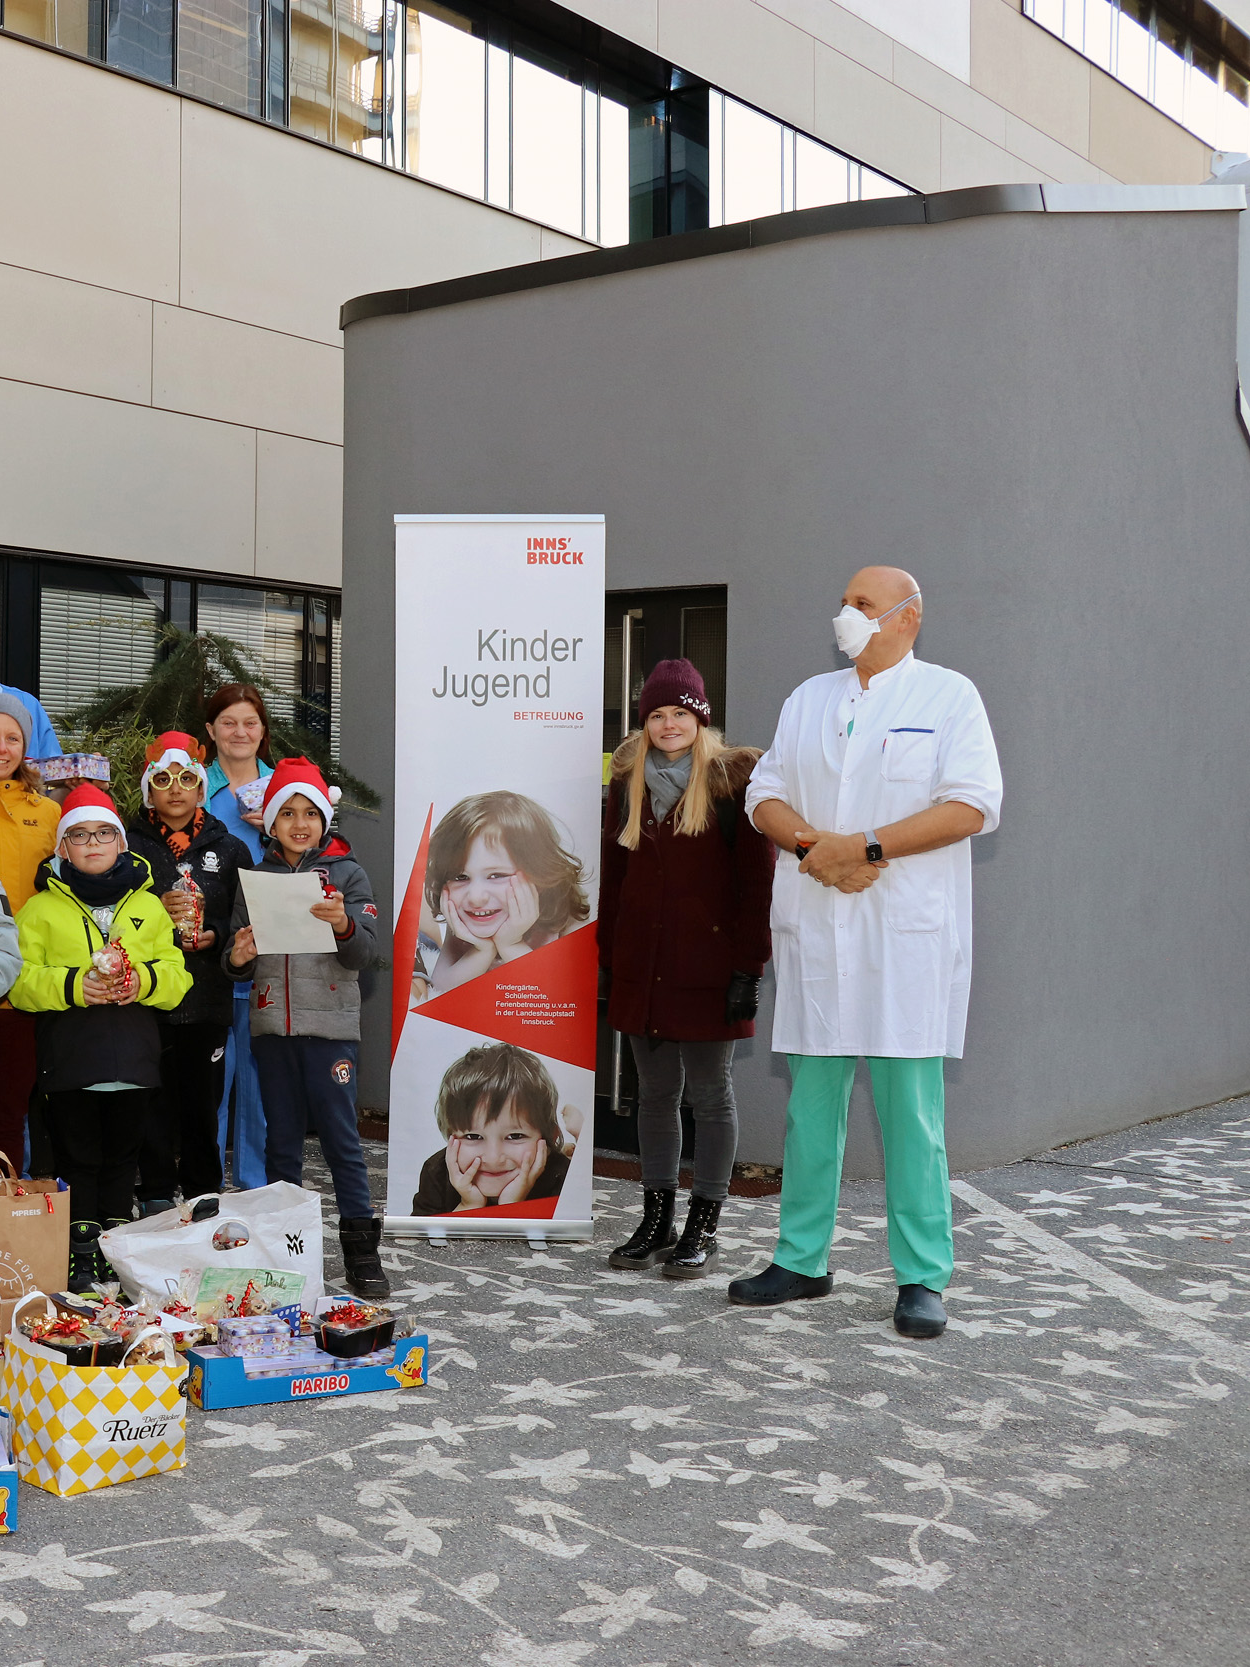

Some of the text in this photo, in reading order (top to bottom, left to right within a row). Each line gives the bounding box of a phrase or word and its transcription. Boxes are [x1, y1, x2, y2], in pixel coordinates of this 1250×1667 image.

[526, 552, 584, 565] BRUCK
[477, 629, 583, 662] Kinder
[432, 666, 551, 707] Jugend
[513, 711, 584, 721] BETREUUNG
[495, 983, 541, 992] Kindergärten,
[504, 992, 549, 1000] Schülerhorte,
[495, 1001, 550, 1009] Ferienbetreuung
[515, 1010, 575, 1018] Landeshauptstadt
[521, 1018, 556, 1026] Innsbruck.
[11, 1209, 42, 1217] MPREIS
[14, 1258, 34, 1281] FÜR
[291, 1374, 349, 1396] HARIBO
[142, 1415, 158, 1423] Der
[102, 1419, 168, 1442] Ruetz
